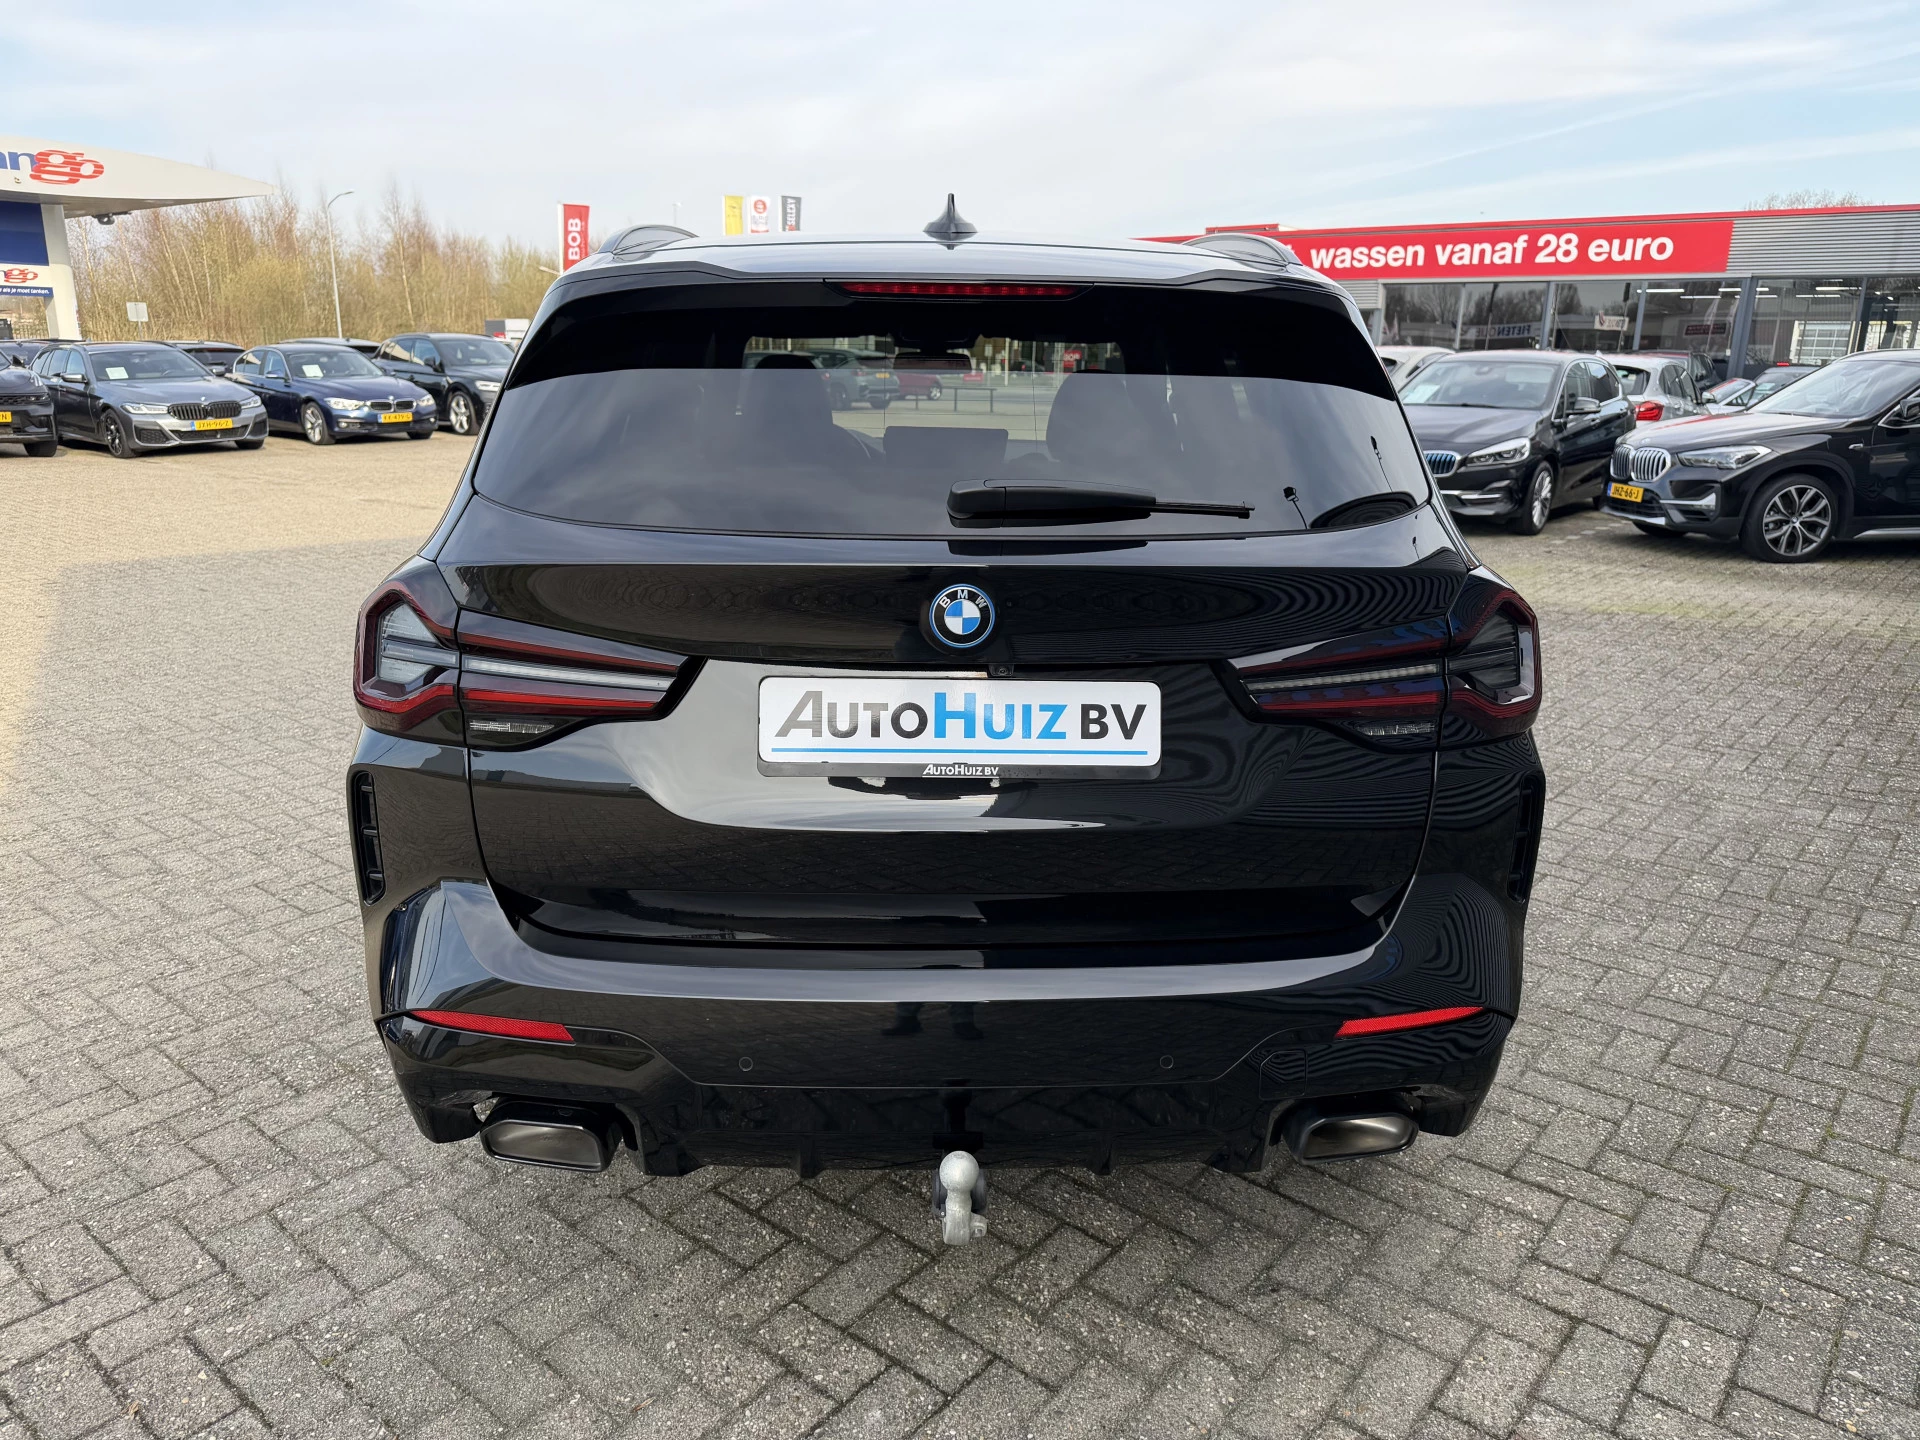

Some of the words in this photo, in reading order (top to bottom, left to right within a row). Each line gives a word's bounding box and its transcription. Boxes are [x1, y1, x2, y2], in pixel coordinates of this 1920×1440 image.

[567, 218, 581, 260] BOB
[1310, 244, 1425, 269] wassen
[1435, 234, 1529, 266] vanaf
[1534, 232, 1579, 264] 28
[1587, 236, 1674, 263] euro
[939, 589, 988, 608] BMW
[1080, 703, 1148, 740] BV
[984, 766, 999, 776] BV
